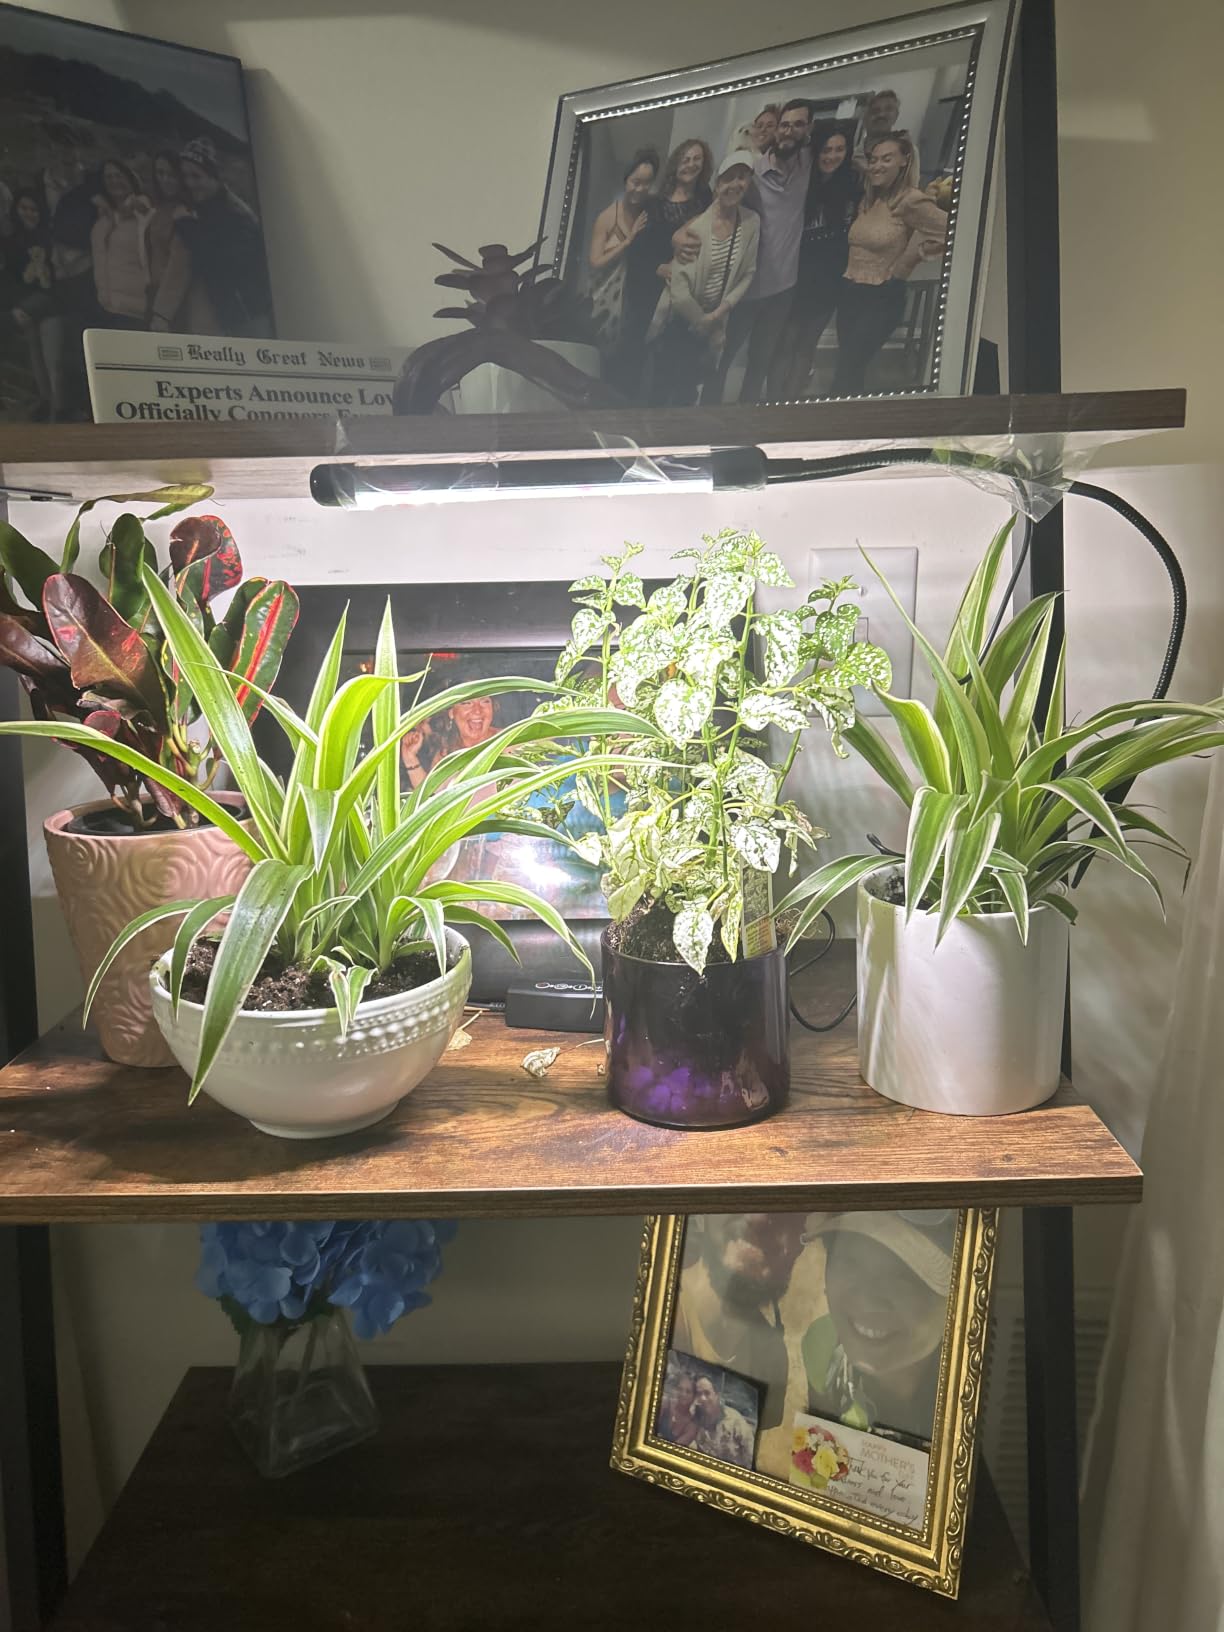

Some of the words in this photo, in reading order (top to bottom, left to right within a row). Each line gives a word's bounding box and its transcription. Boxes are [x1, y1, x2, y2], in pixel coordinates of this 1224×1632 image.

[187, 344, 246, 366] Really
[256, 348, 306, 366] Great
[318, 351, 366, 368] News
[156, 380, 243, 404] Experts
[249, 384, 352, 404] Announce
[357, 388, 393, 406] Lov
[115, 401, 221, 422] Officially
